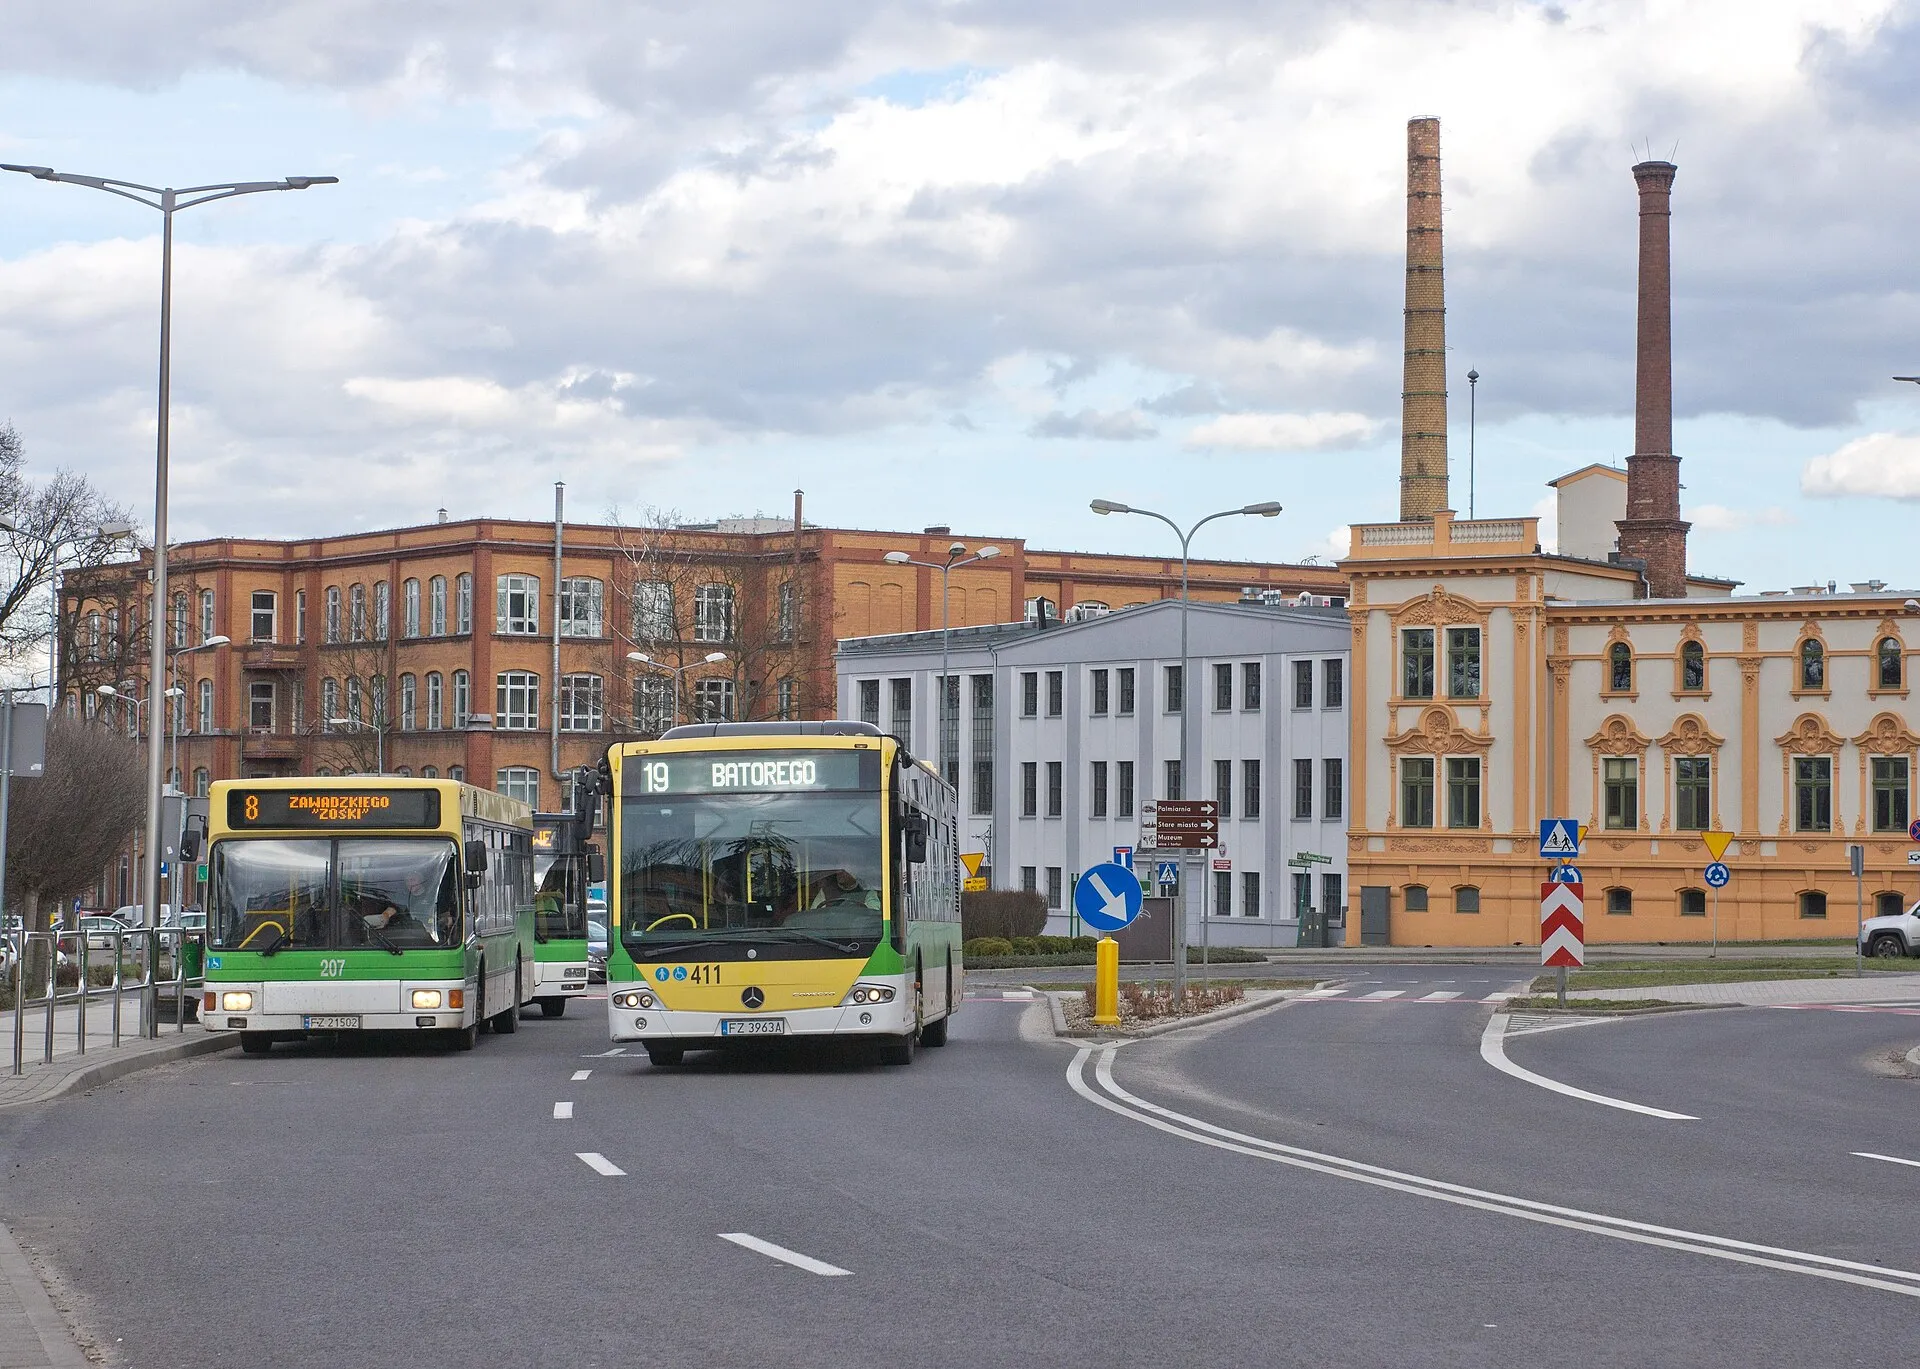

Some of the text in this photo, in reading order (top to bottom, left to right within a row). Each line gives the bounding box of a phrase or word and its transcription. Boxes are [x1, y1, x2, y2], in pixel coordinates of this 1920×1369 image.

[643, 760, 816, 793] 19 BATOREGO
[245, 795, 389, 820] 8 ZAWADZKIEGO
[320, 959, 346, 977] 207
[690, 964, 721, 985] 411
[311, 1018, 358, 1028] FZ 21502
[729, 1021, 782, 1034] FZ 3963A
